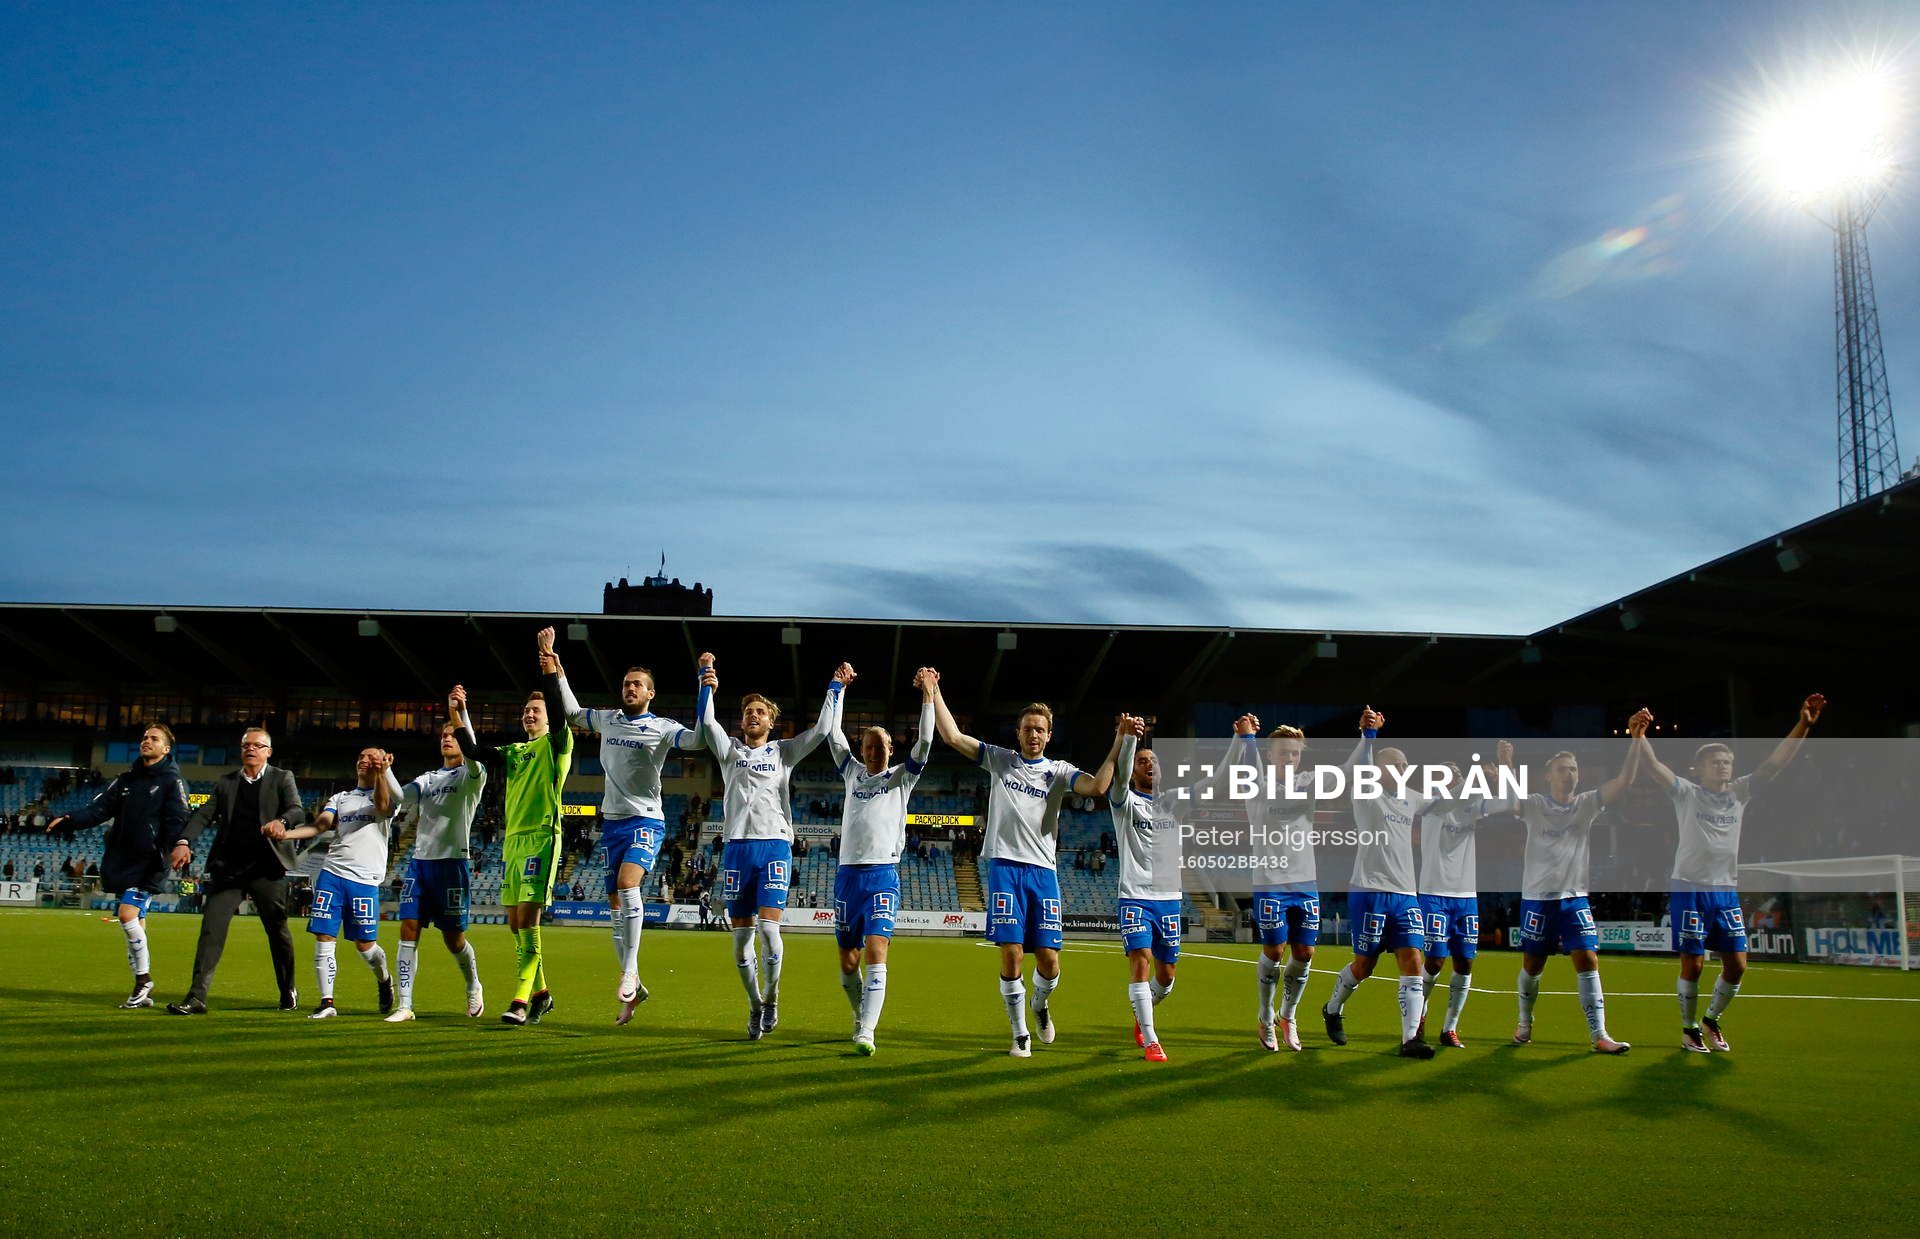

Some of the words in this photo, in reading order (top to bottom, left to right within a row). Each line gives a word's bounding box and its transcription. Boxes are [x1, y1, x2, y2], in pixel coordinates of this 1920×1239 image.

[606, 738, 644, 750] HOLMEN
[735, 760, 776, 772] HOMEN
[1004, 779, 1049, 799] HOLMEN
[1603, 928, 1631, 941] SEFAB
[1635, 929, 1665, 943] Scandic
[1750, 929, 1795, 955] dium
